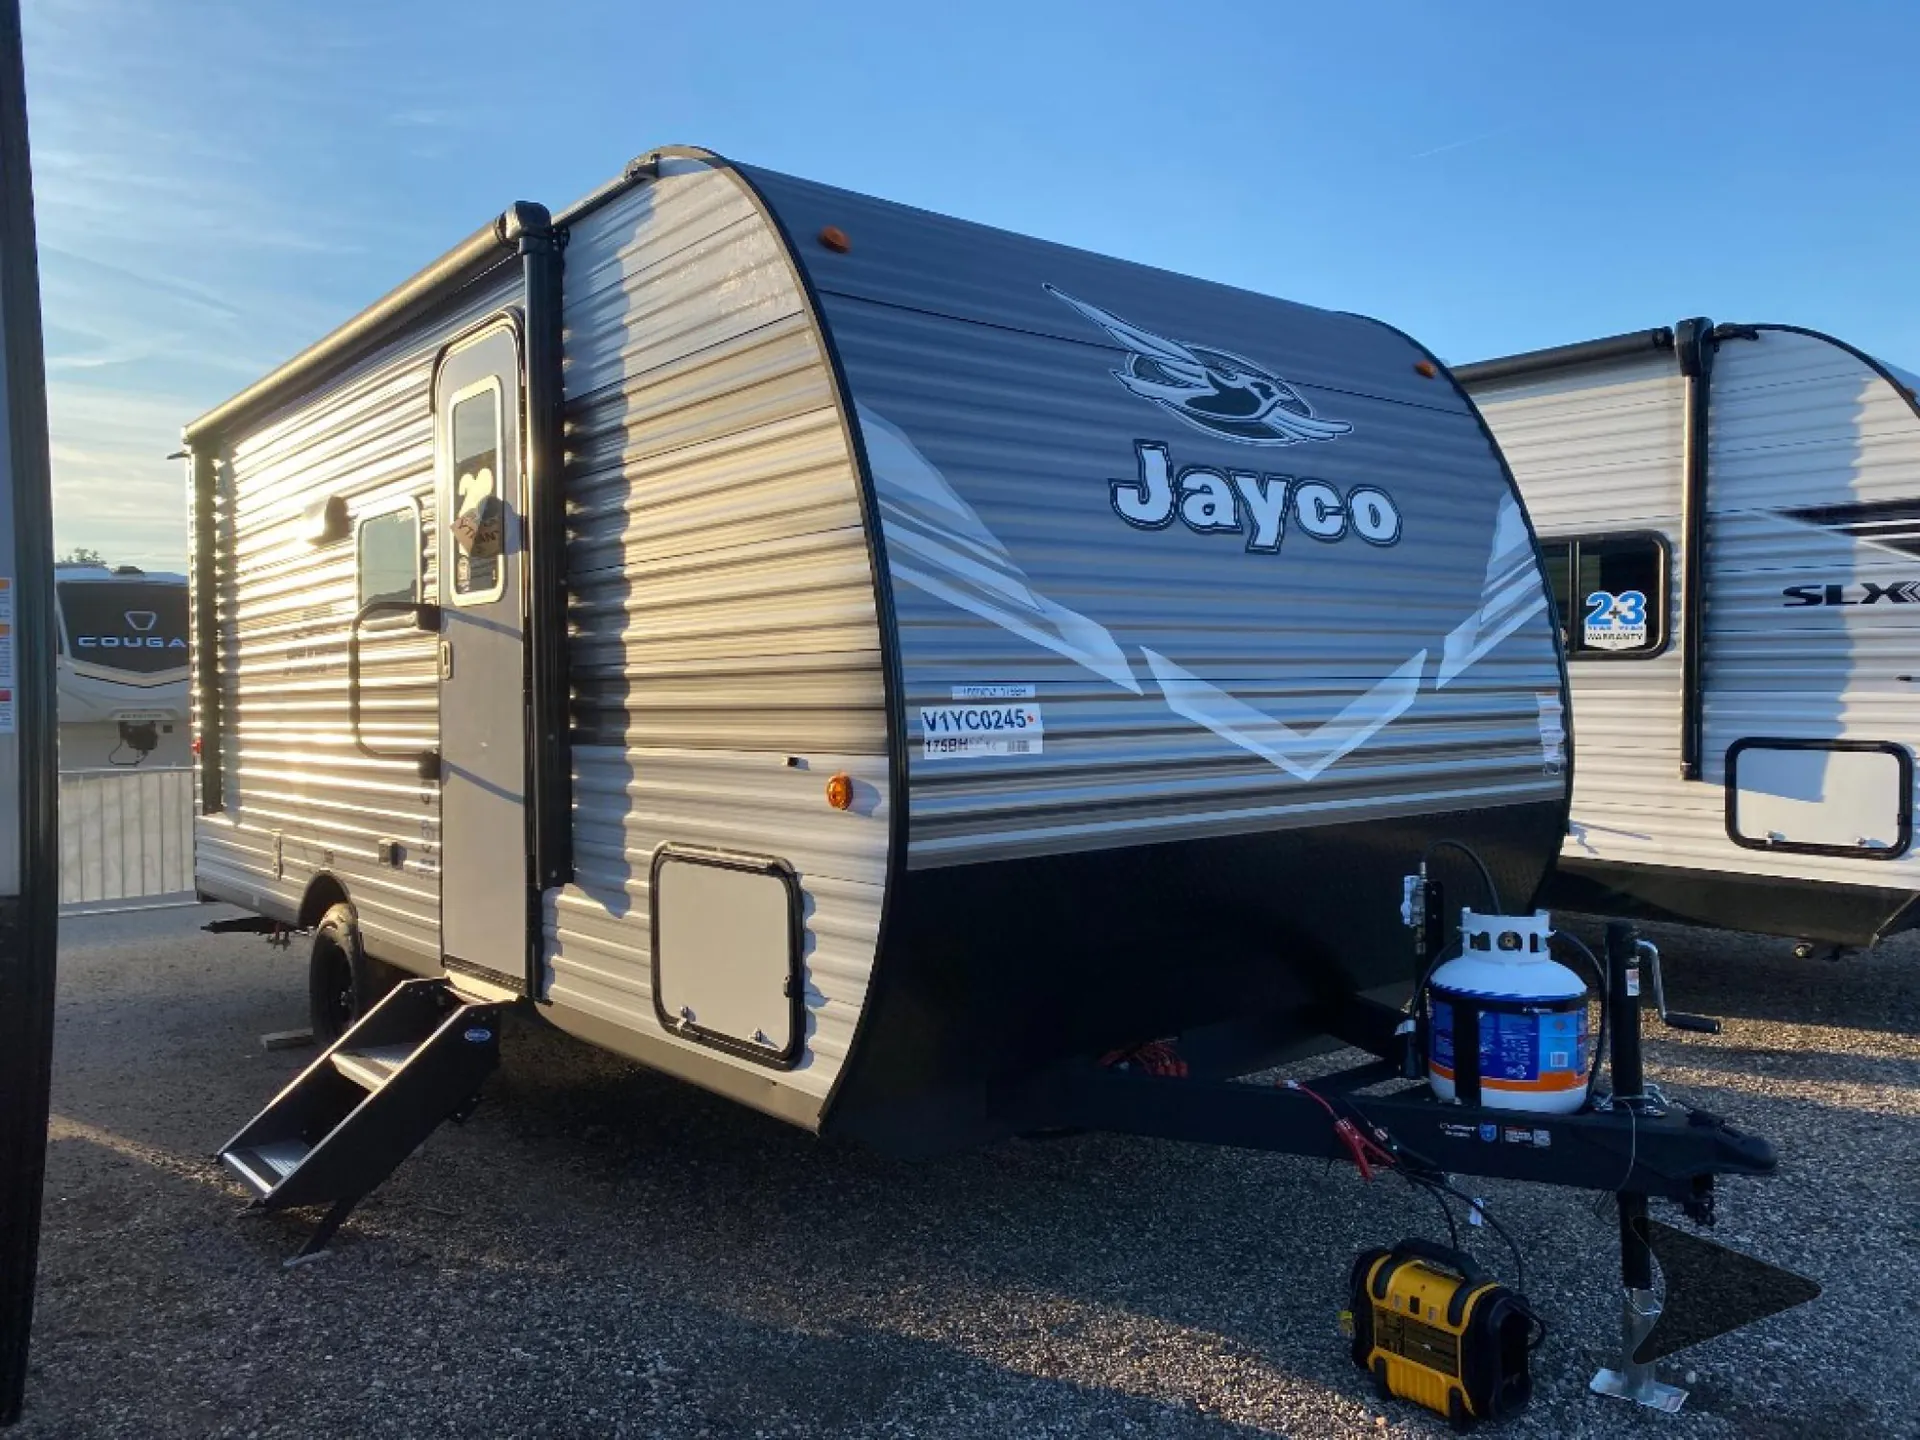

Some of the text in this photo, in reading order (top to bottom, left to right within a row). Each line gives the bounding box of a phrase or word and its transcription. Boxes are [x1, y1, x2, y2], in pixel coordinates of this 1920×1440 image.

[1109, 439, 1403, 554] Jayco
[78, 636, 187, 648] COUGA
[922, 708, 1027, 732] V1YC0245
